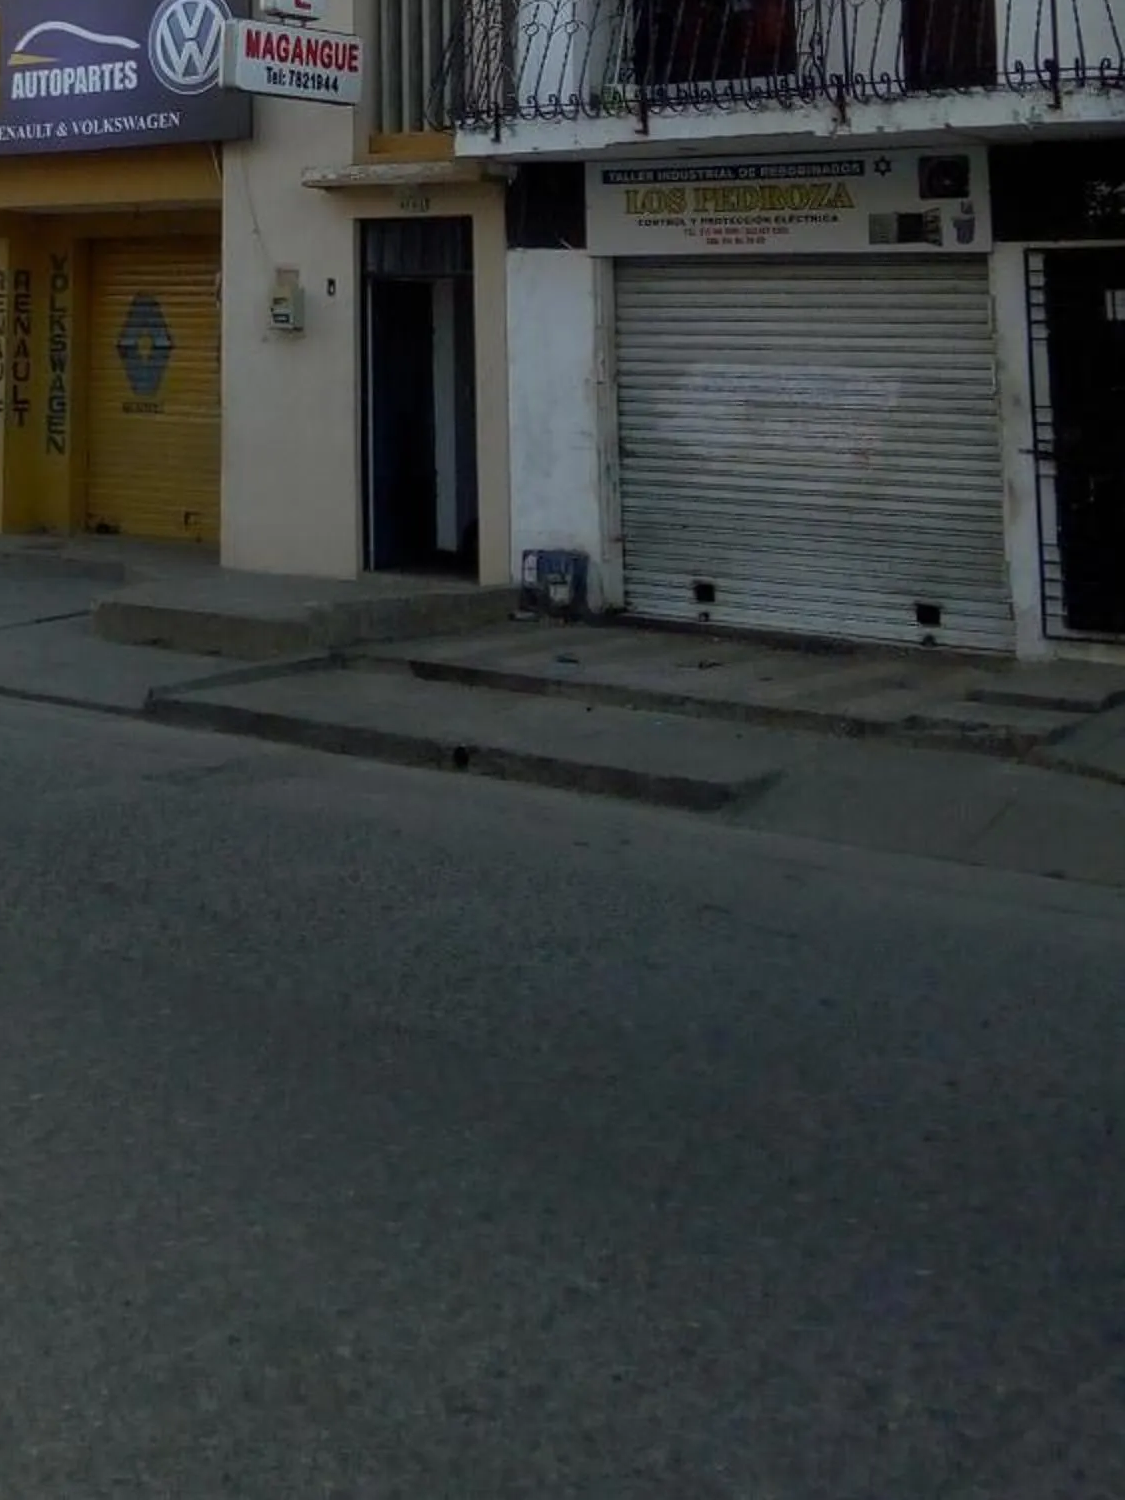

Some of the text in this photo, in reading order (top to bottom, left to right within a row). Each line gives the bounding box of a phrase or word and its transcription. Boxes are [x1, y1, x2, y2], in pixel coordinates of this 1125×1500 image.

[245, 28, 360, 74] MAGANGUE
[10, 60, 139, 102] AUTOPARTES
[55, 121, 68, 138] &
[71, 111, 181, 136] VOLKSWAGEN
[609, 169, 654, 182] TALLER
[657, 165, 736, 181] INDUSTRIAL
[738, 165, 757, 179] DE
[625, 181, 856, 214] LOS PEDROZA
[11, 270, 31, 429] RENAULT
[46, 253, 69, 455] VOLKSWAGEN
